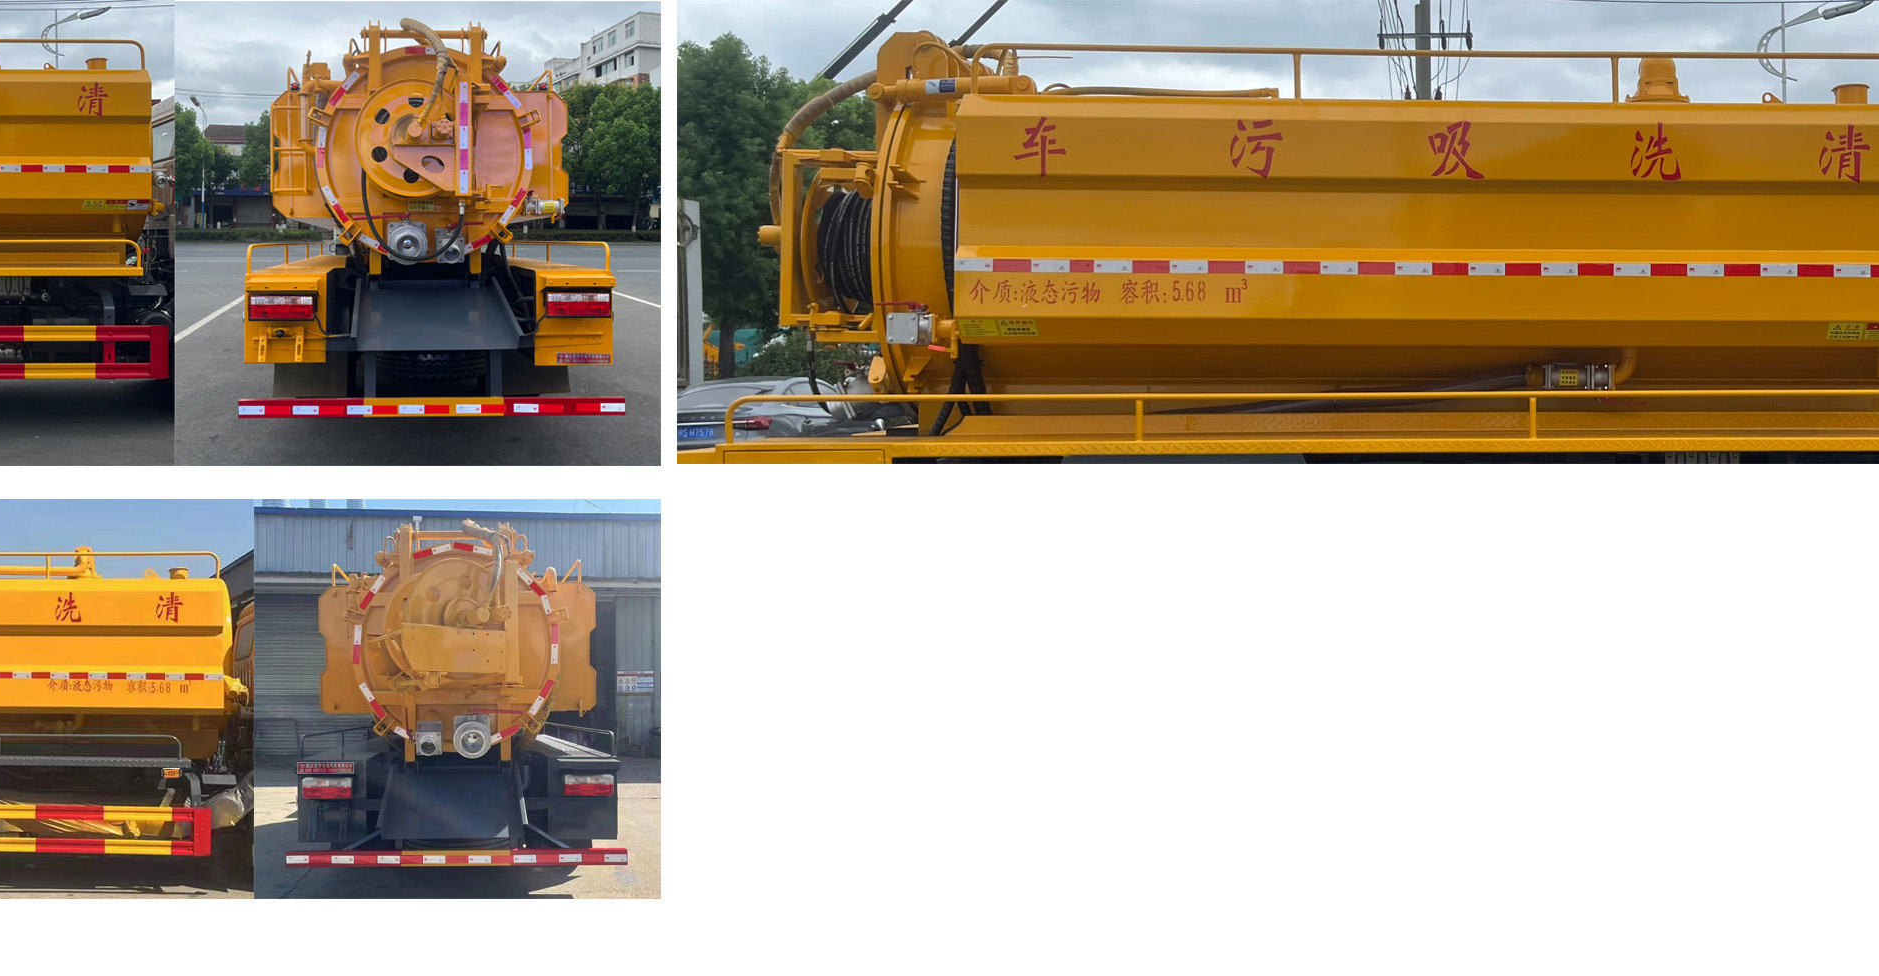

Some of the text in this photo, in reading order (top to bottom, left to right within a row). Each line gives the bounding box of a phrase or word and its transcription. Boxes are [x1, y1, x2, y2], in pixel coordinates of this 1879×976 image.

[969, 278, 1101, 305] 介质:液态污物
